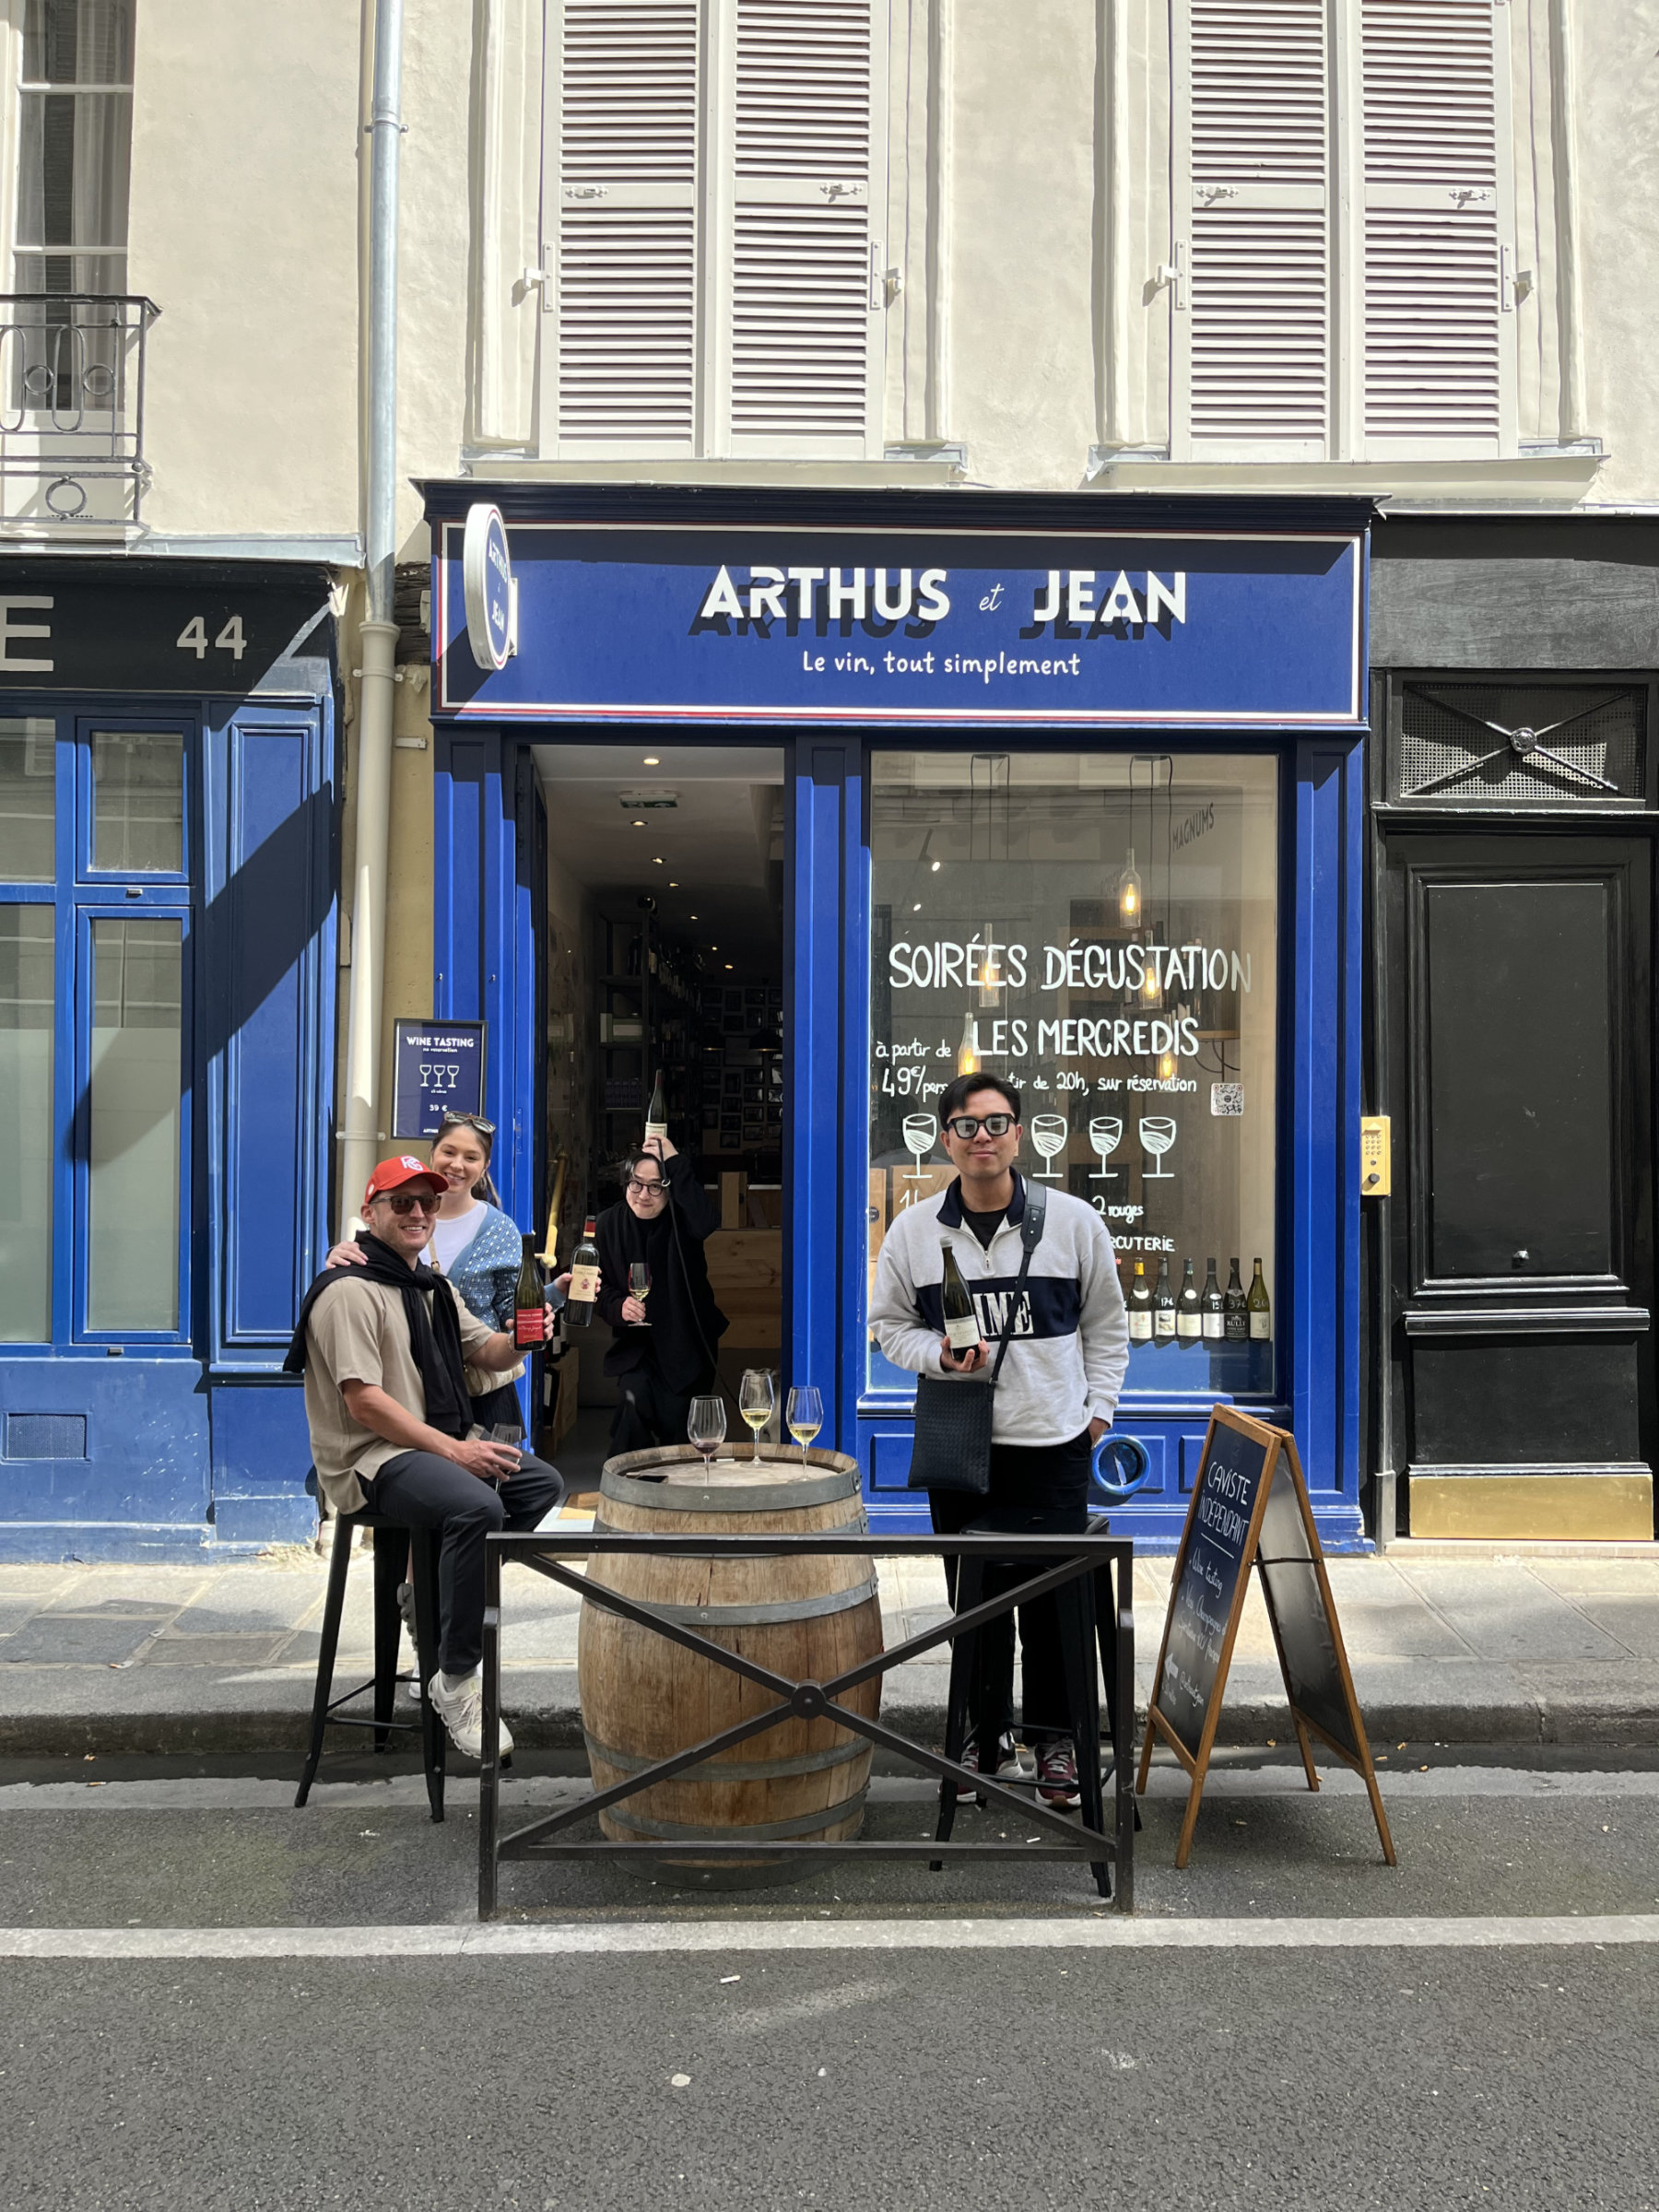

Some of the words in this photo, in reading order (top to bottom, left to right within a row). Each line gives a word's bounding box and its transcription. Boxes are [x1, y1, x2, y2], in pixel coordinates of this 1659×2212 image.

[488, 537, 508, 583] ARTHUS
[700, 564, 950, 620] ARTHUS
[979, 582, 1005, 612] et
[1034, 569, 1187, 625] JEAN
[0, 595, 53, 672] E
[491, 599, 505, 635] JEAN
[176, 616, 247, 660] 44
[803, 651, 826, 672] Le
[834, 652, 876, 675] vin,
[883, 651, 935, 674] tout
[944, 651, 1081, 685] simplement
[1172, 802, 1215, 853] MAGNUMS
[888, 933, 1028, 989] SOIRÉES
[1041, 938, 1252, 994] DÉGUSTATION
[406, 1036, 431, 1046] WINE
[434, 1037, 475, 1048] TASTING
[876, 1041, 889, 1058] à
[892, 1038, 931, 1065] partir
[935, 1039, 952, 1058] de
[972, 1019, 1028, 1056] LES
[1038, 1018, 1199, 1057] MERCREDIS
[1006, 1072, 1027, 1089] tir
[1033, 1075, 1049, 1090] de
[1056, 1072, 1089, 1096] 20h,
[1097, 1077, 1123, 1091] sur
[1126, 1073, 1197, 1092] réservation
[1091, 1194, 1106, 1216] 2
[1108, 1205, 1145, 1224] rouges
[1208, 1462, 1252, 1505] CAVISTE
[1198, 1489, 1249, 1546] INDÉPENDANT
[1206, 1560, 1223, 1599] tasting
